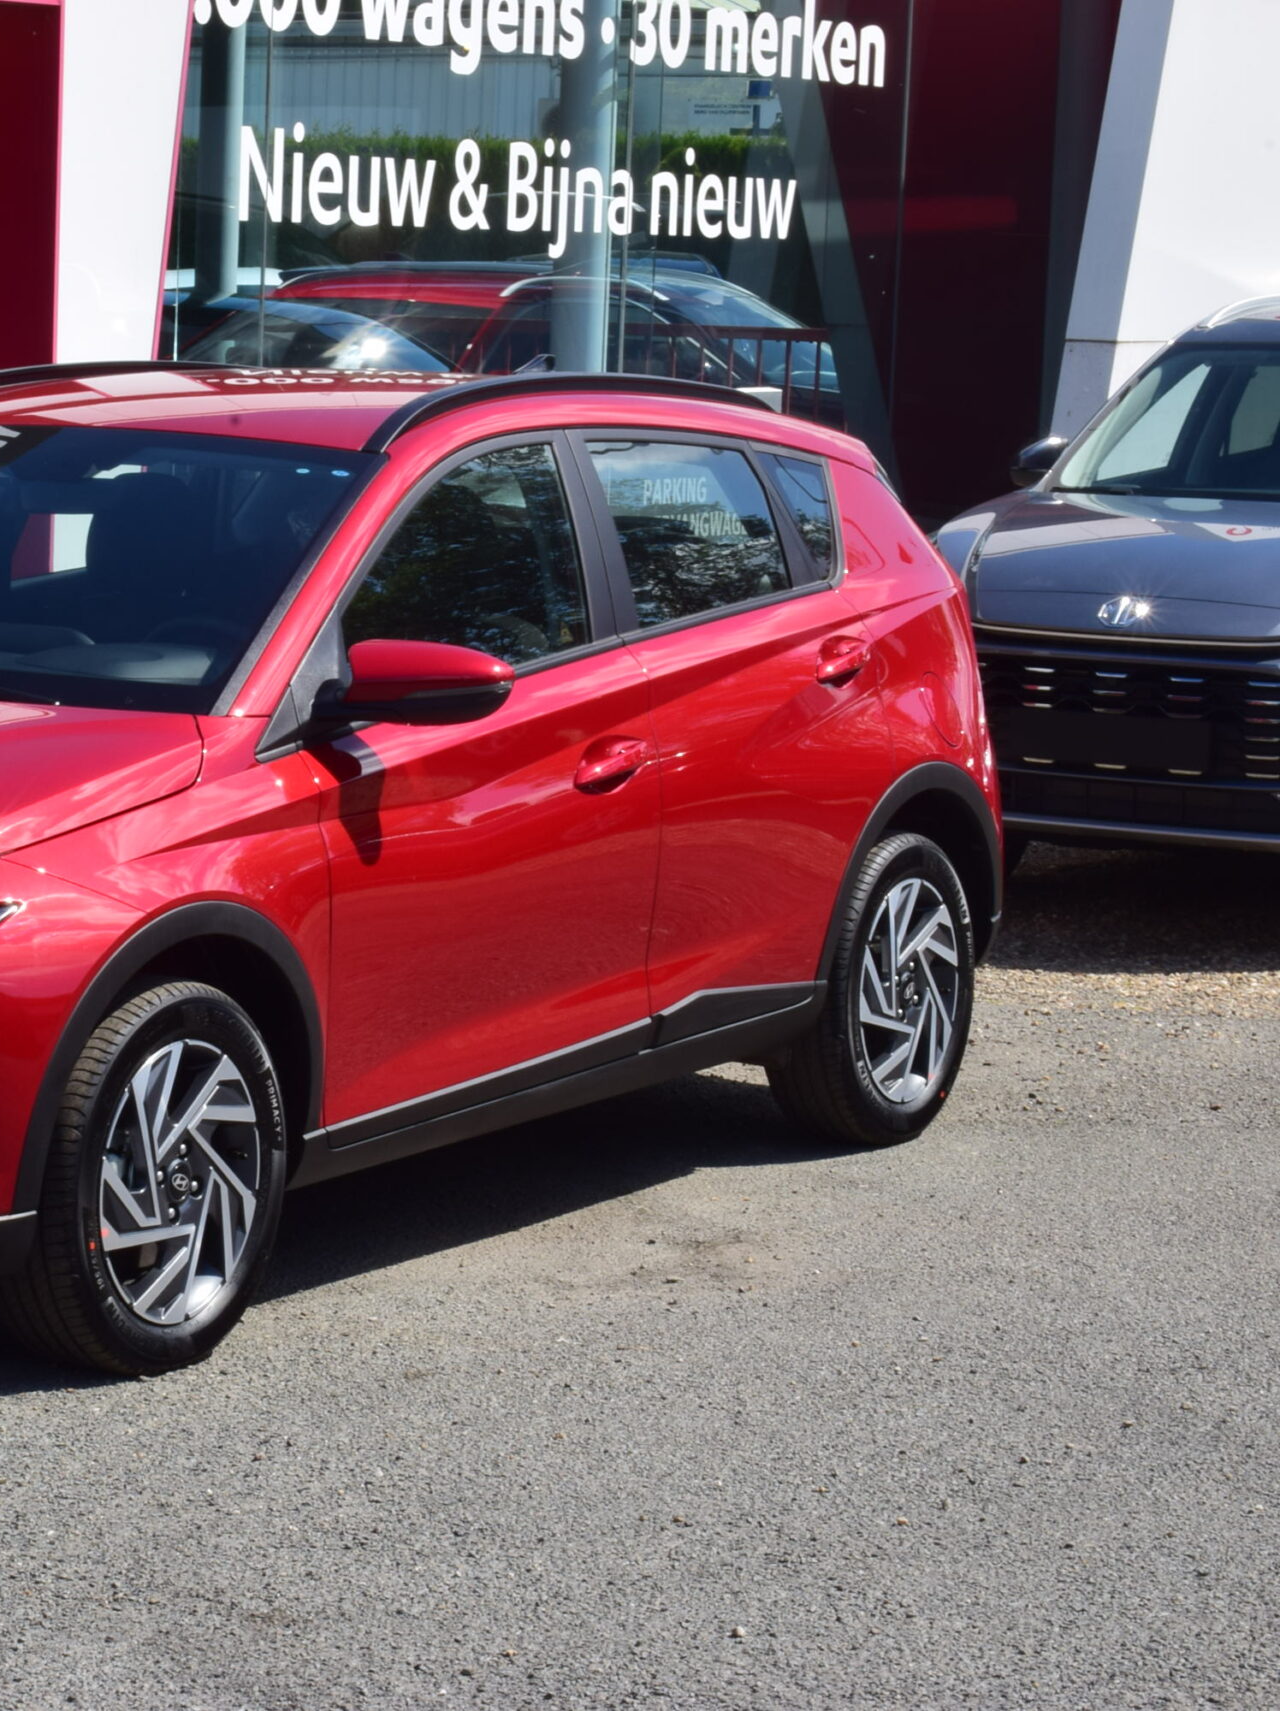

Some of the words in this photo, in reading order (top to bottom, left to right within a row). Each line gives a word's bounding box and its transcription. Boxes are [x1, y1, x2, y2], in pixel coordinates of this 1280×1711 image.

[359, 0, 585, 75] wagens
[630, 0, 692, 68] 30
[704, 0, 886, 87] merken
[238, 122, 437, 228] Nieuw
[449, 138, 490, 231] &
[507, 138, 634, 259] Bijna
[649, 147, 797, 241] nieuw
[643, 477, 707, 505] PARKING
[265, 1079, 282, 1134] PRIMACY
